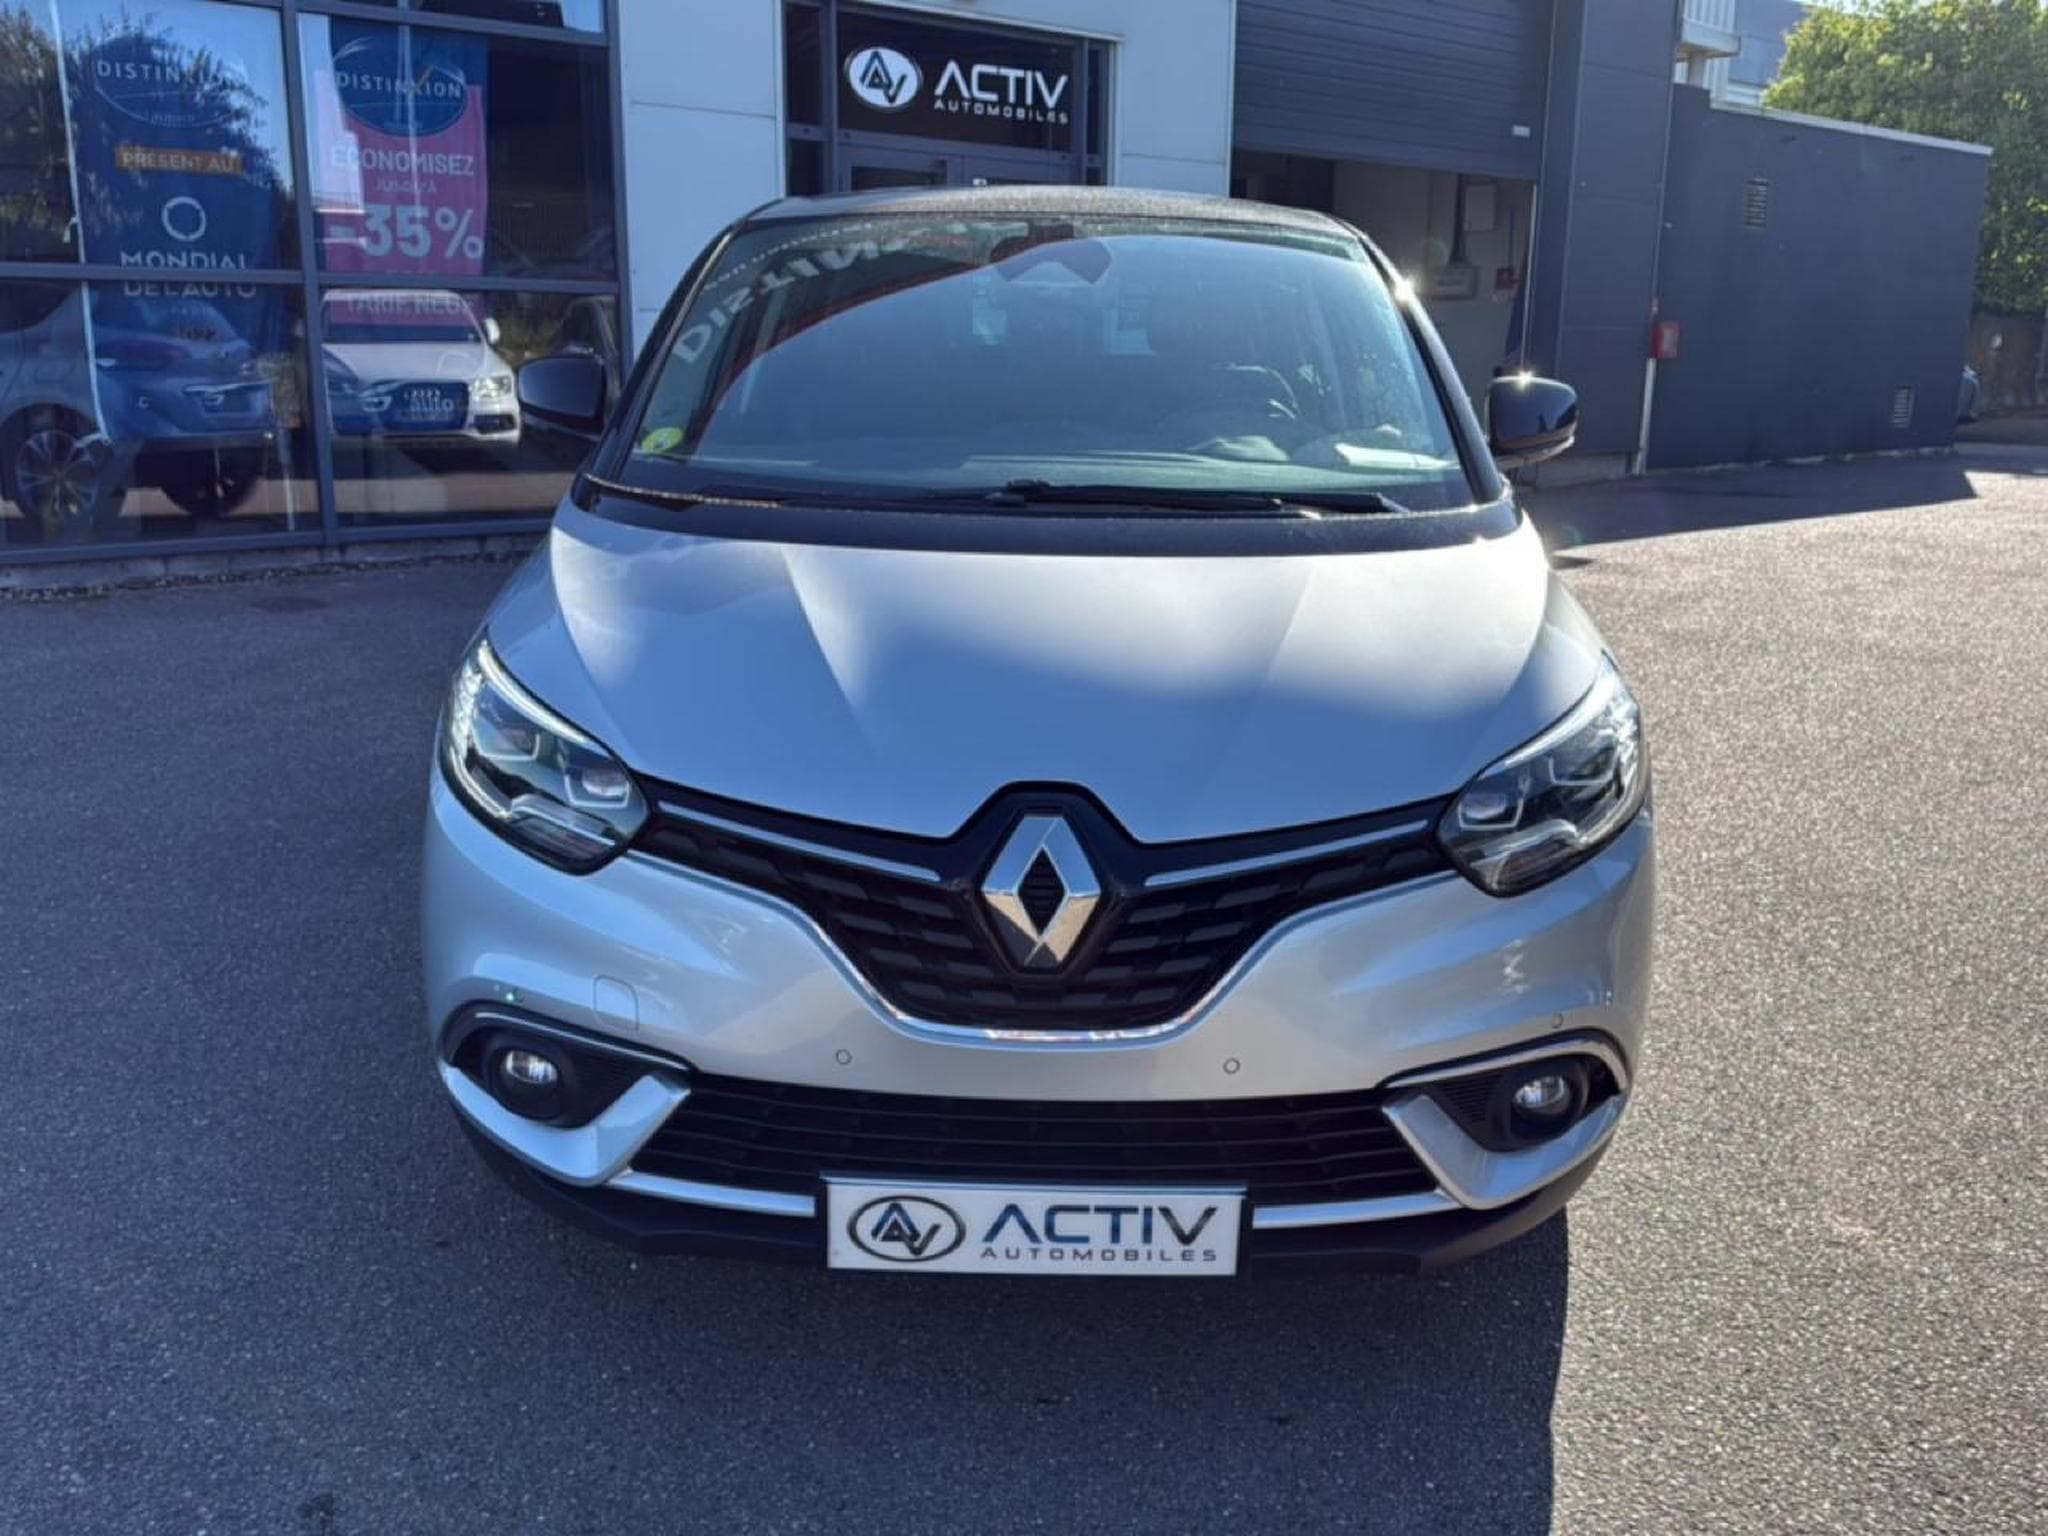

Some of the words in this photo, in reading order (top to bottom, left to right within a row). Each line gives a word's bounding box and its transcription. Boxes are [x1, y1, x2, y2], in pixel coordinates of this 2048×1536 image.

[336, 70, 462, 99] DISTINXION
[934, 60, 1069, 108] ACTIV
[934, 98, 1069, 125] AUTOMOBILES
[329, 204, 485, 260] -35%
[120, 251, 246, 271] MONDIAL
[982, 1202, 1218, 1247] ACTIV
[981, 1246, 1217, 1263] AUTOMOBILES
